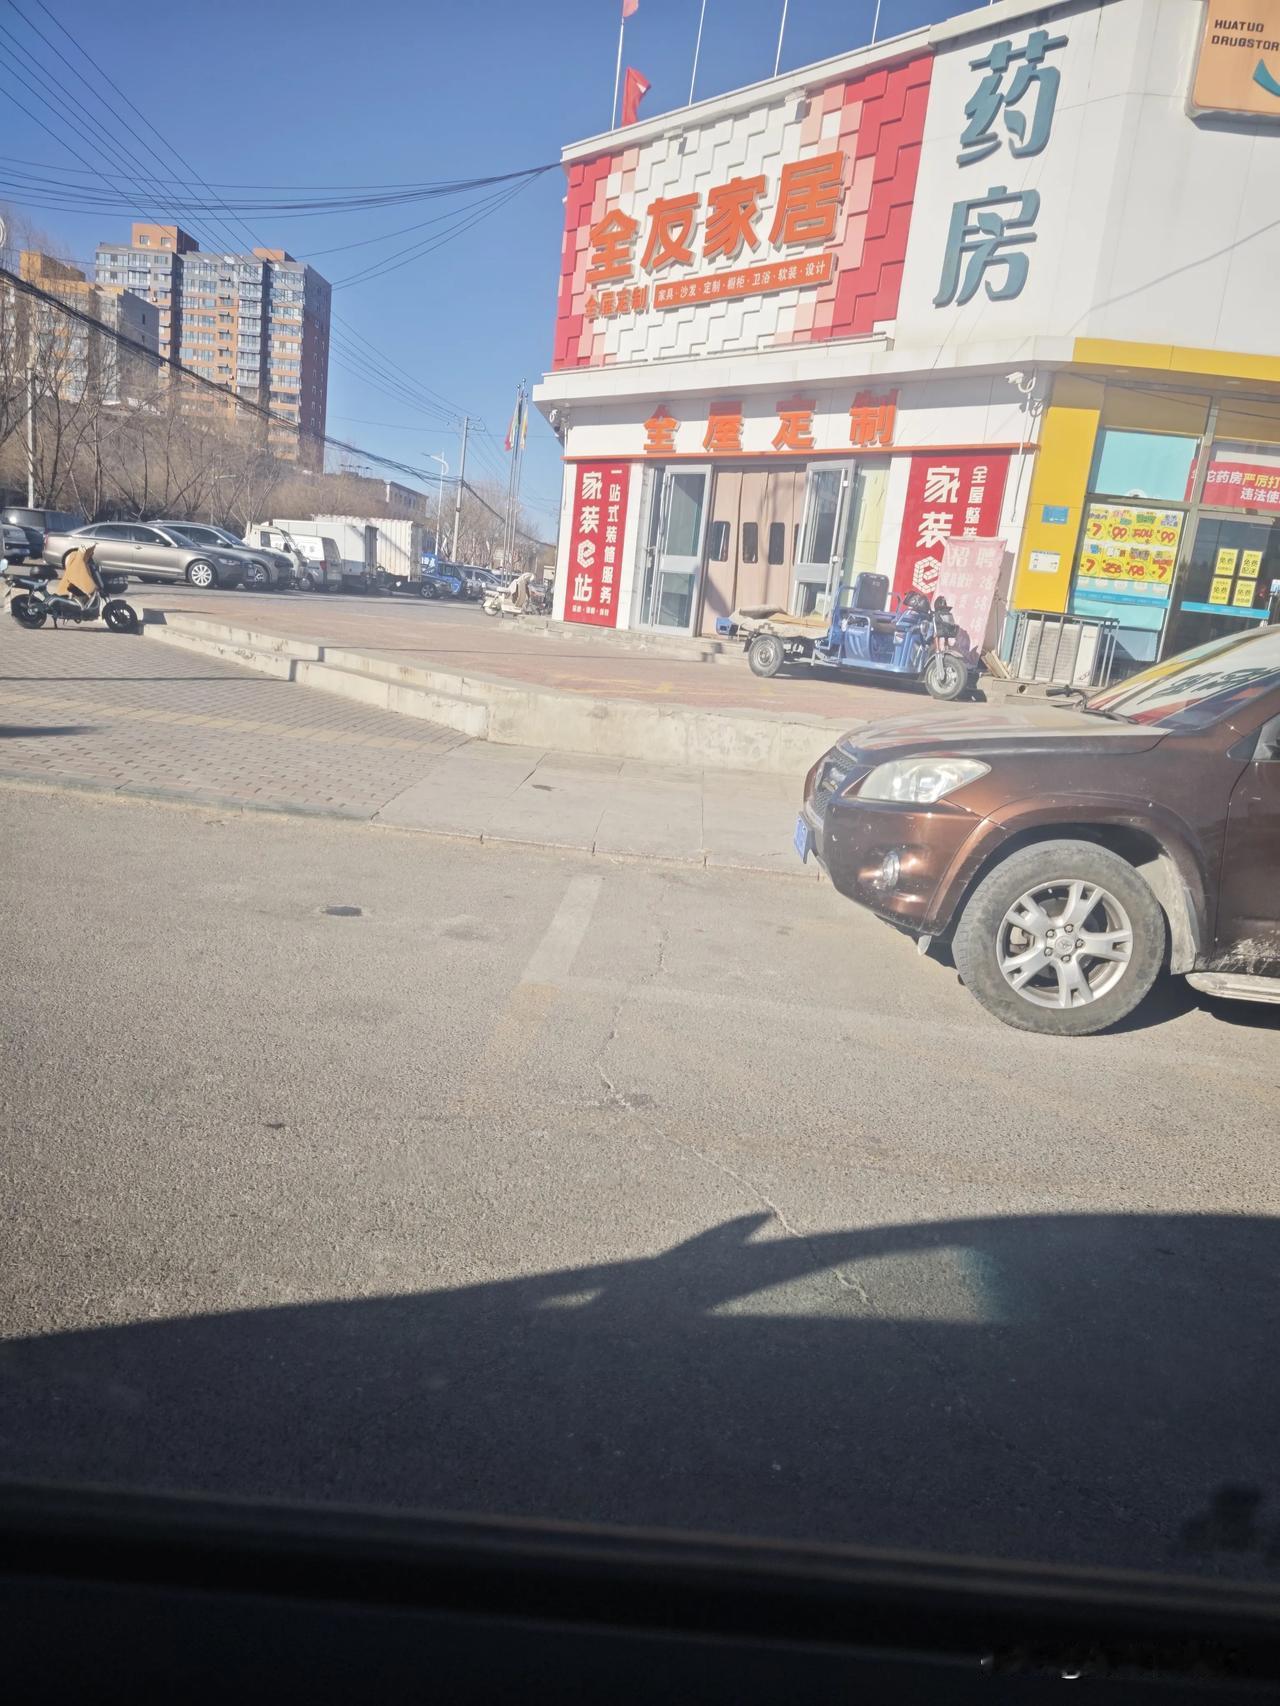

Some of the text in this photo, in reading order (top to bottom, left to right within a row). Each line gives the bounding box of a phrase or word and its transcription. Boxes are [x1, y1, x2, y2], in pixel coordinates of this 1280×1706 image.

[1211, 35, 1280, 51] DRUGSTOR
[1214, 19, 1264, 33] HUATUO
[932, 30, 1069, 309] 药房
[584, 151, 845, 285] 全友家居
[585, 284, 649, 319] 全屋定制
[643, 388, 899, 452] 全屋定制
[599, 469, 622, 604] 一站式装修服务
